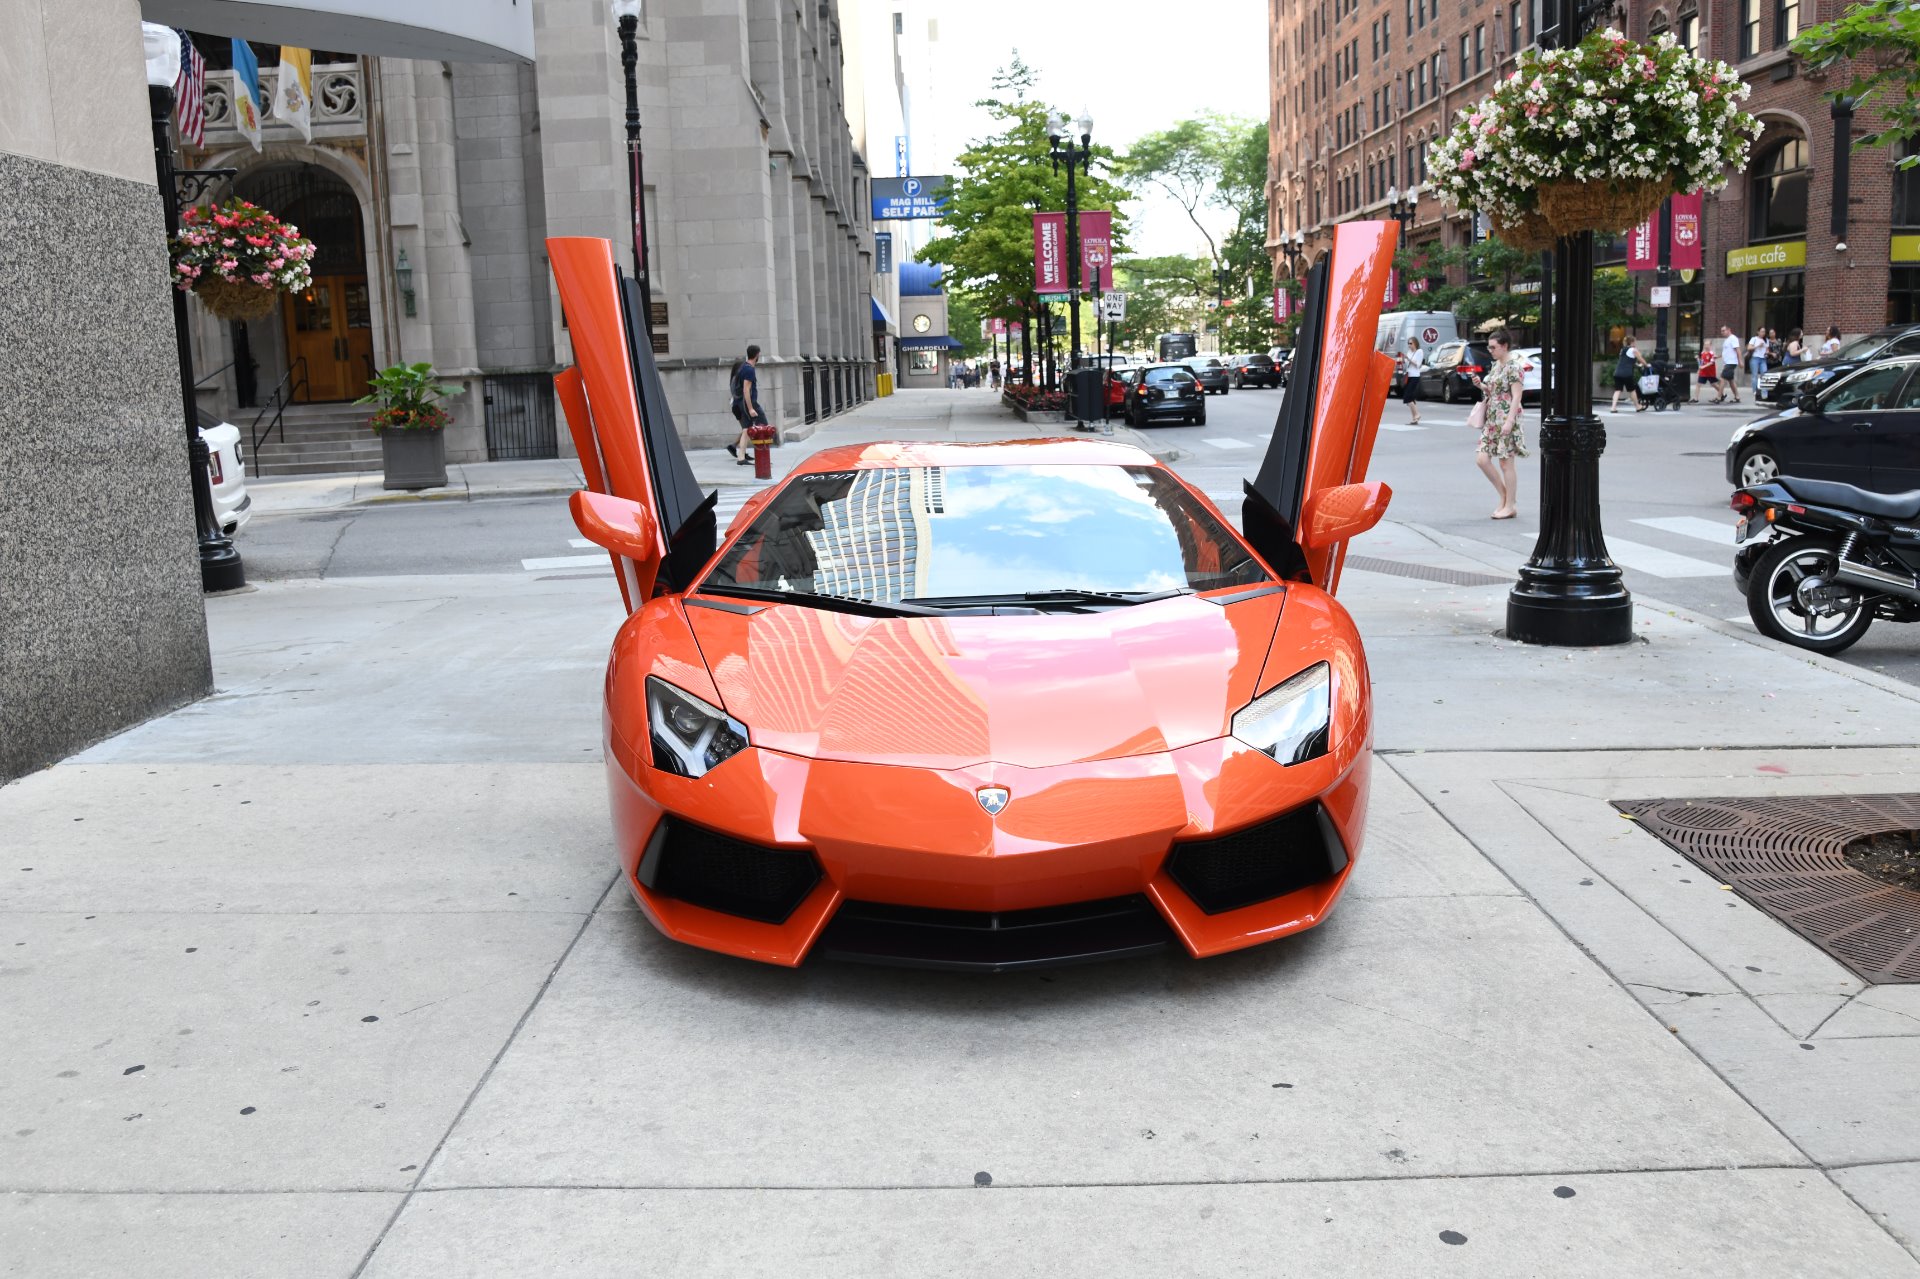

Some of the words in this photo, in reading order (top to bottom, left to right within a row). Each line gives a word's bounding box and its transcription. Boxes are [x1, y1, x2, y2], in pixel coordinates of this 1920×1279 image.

[907, 181, 918, 194] P
[890, 198, 912, 206] MAG
[913, 197, 936, 206] MILL
[882, 207, 910, 217] SELF
[1635, 223, 1645, 260] WELC
[1042, 222, 1053, 284] WELCOME
[1760, 244, 1787, 264] café
[1106, 294, 1123, 302] ONE
